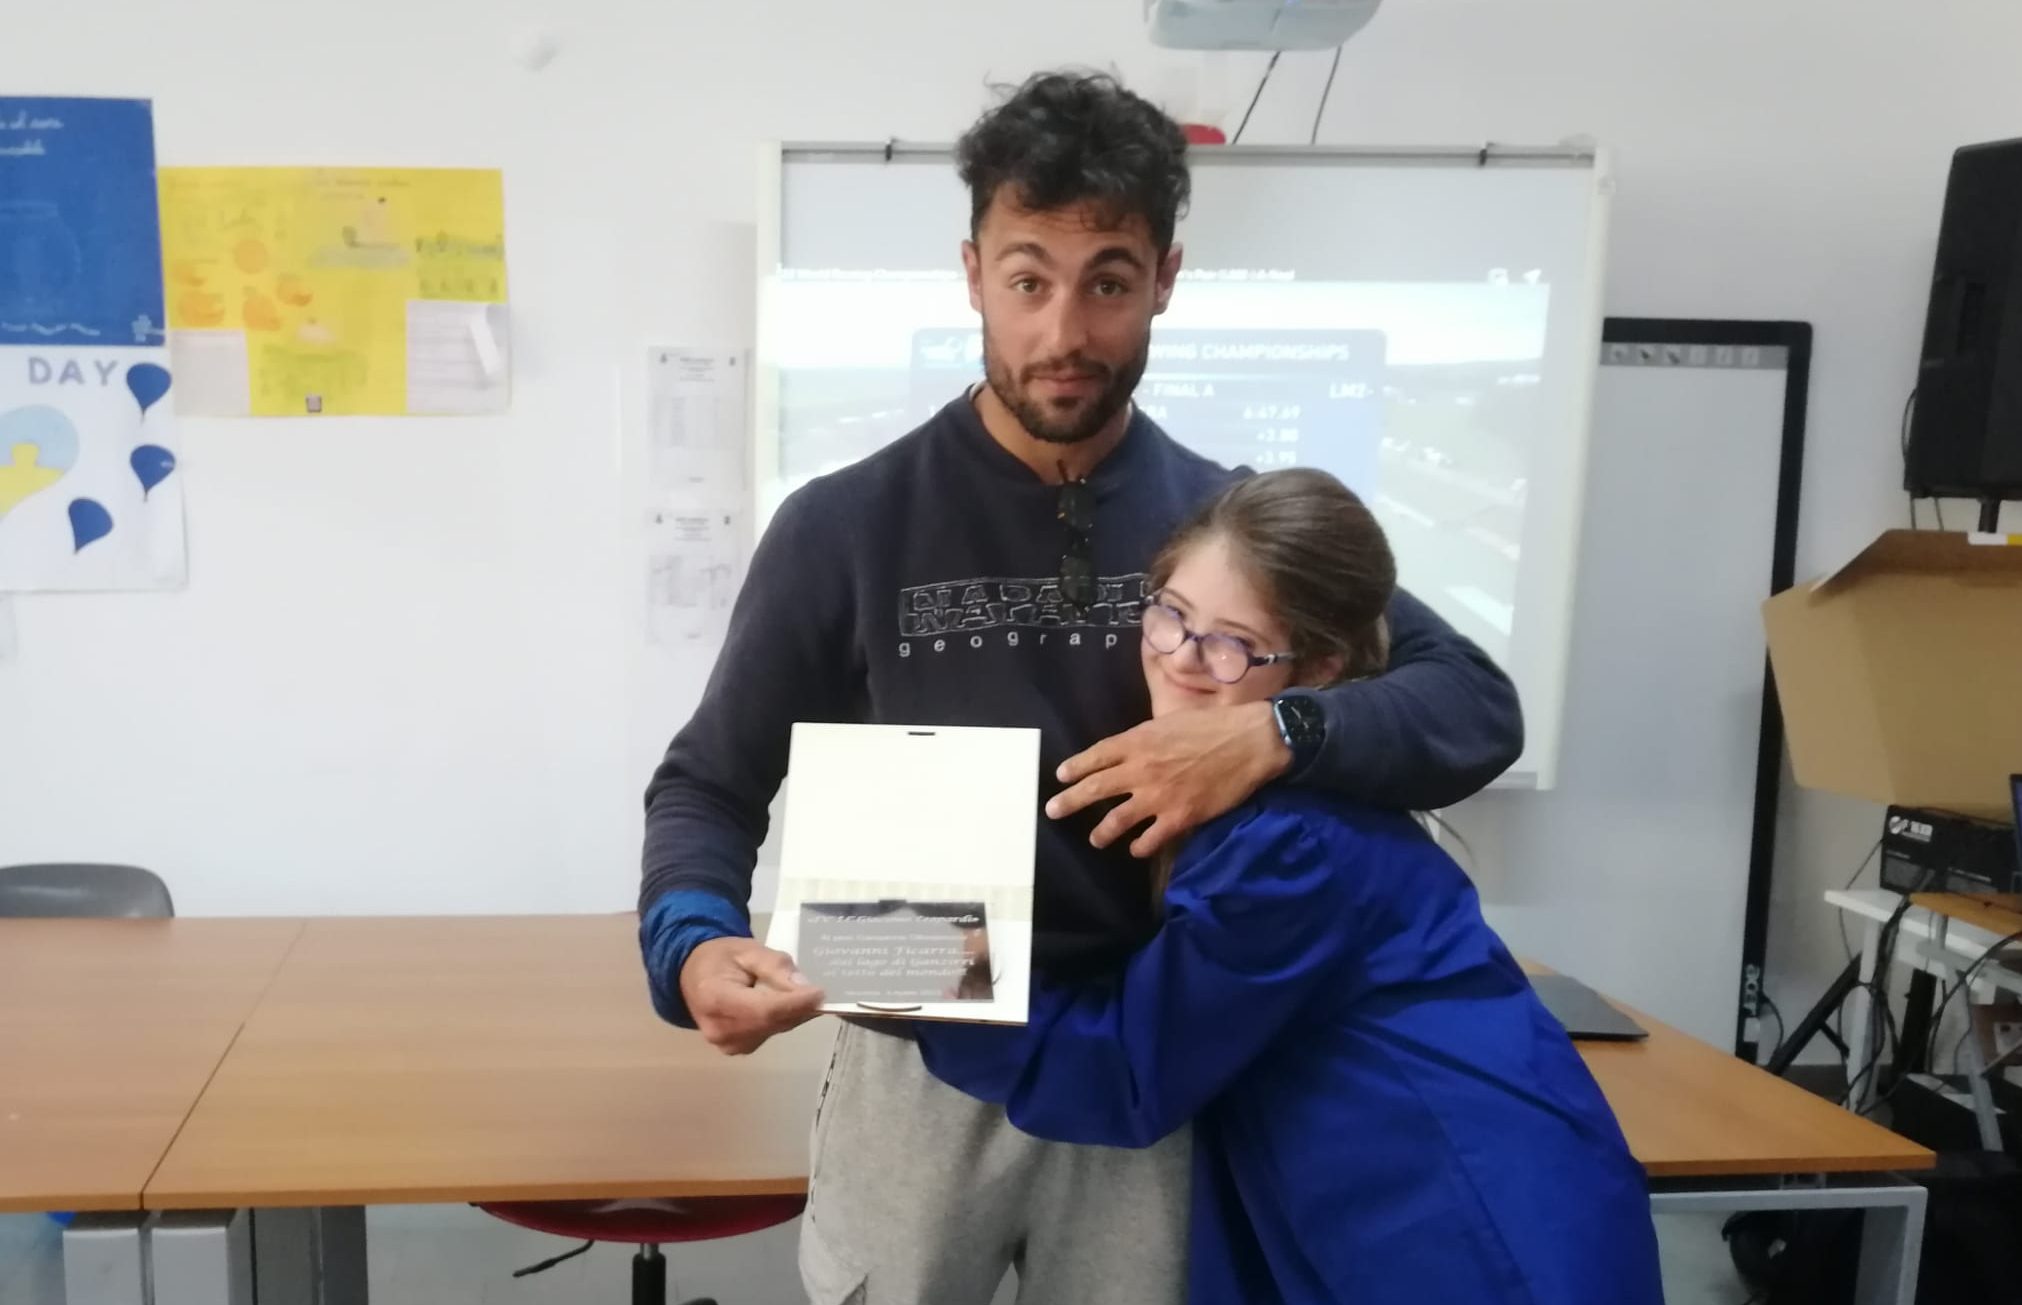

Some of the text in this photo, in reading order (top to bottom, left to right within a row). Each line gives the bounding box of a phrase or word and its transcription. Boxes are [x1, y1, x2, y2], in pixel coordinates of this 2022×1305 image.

[1200, 344, 1350, 361] CHAMPIONSHIPS
[28, 356, 119, 387] DAY
[1153, 383, 1200, 398] FINAL
[1203, 384, 1215, 397] A
[899, 630, 1118, 657] geograp
